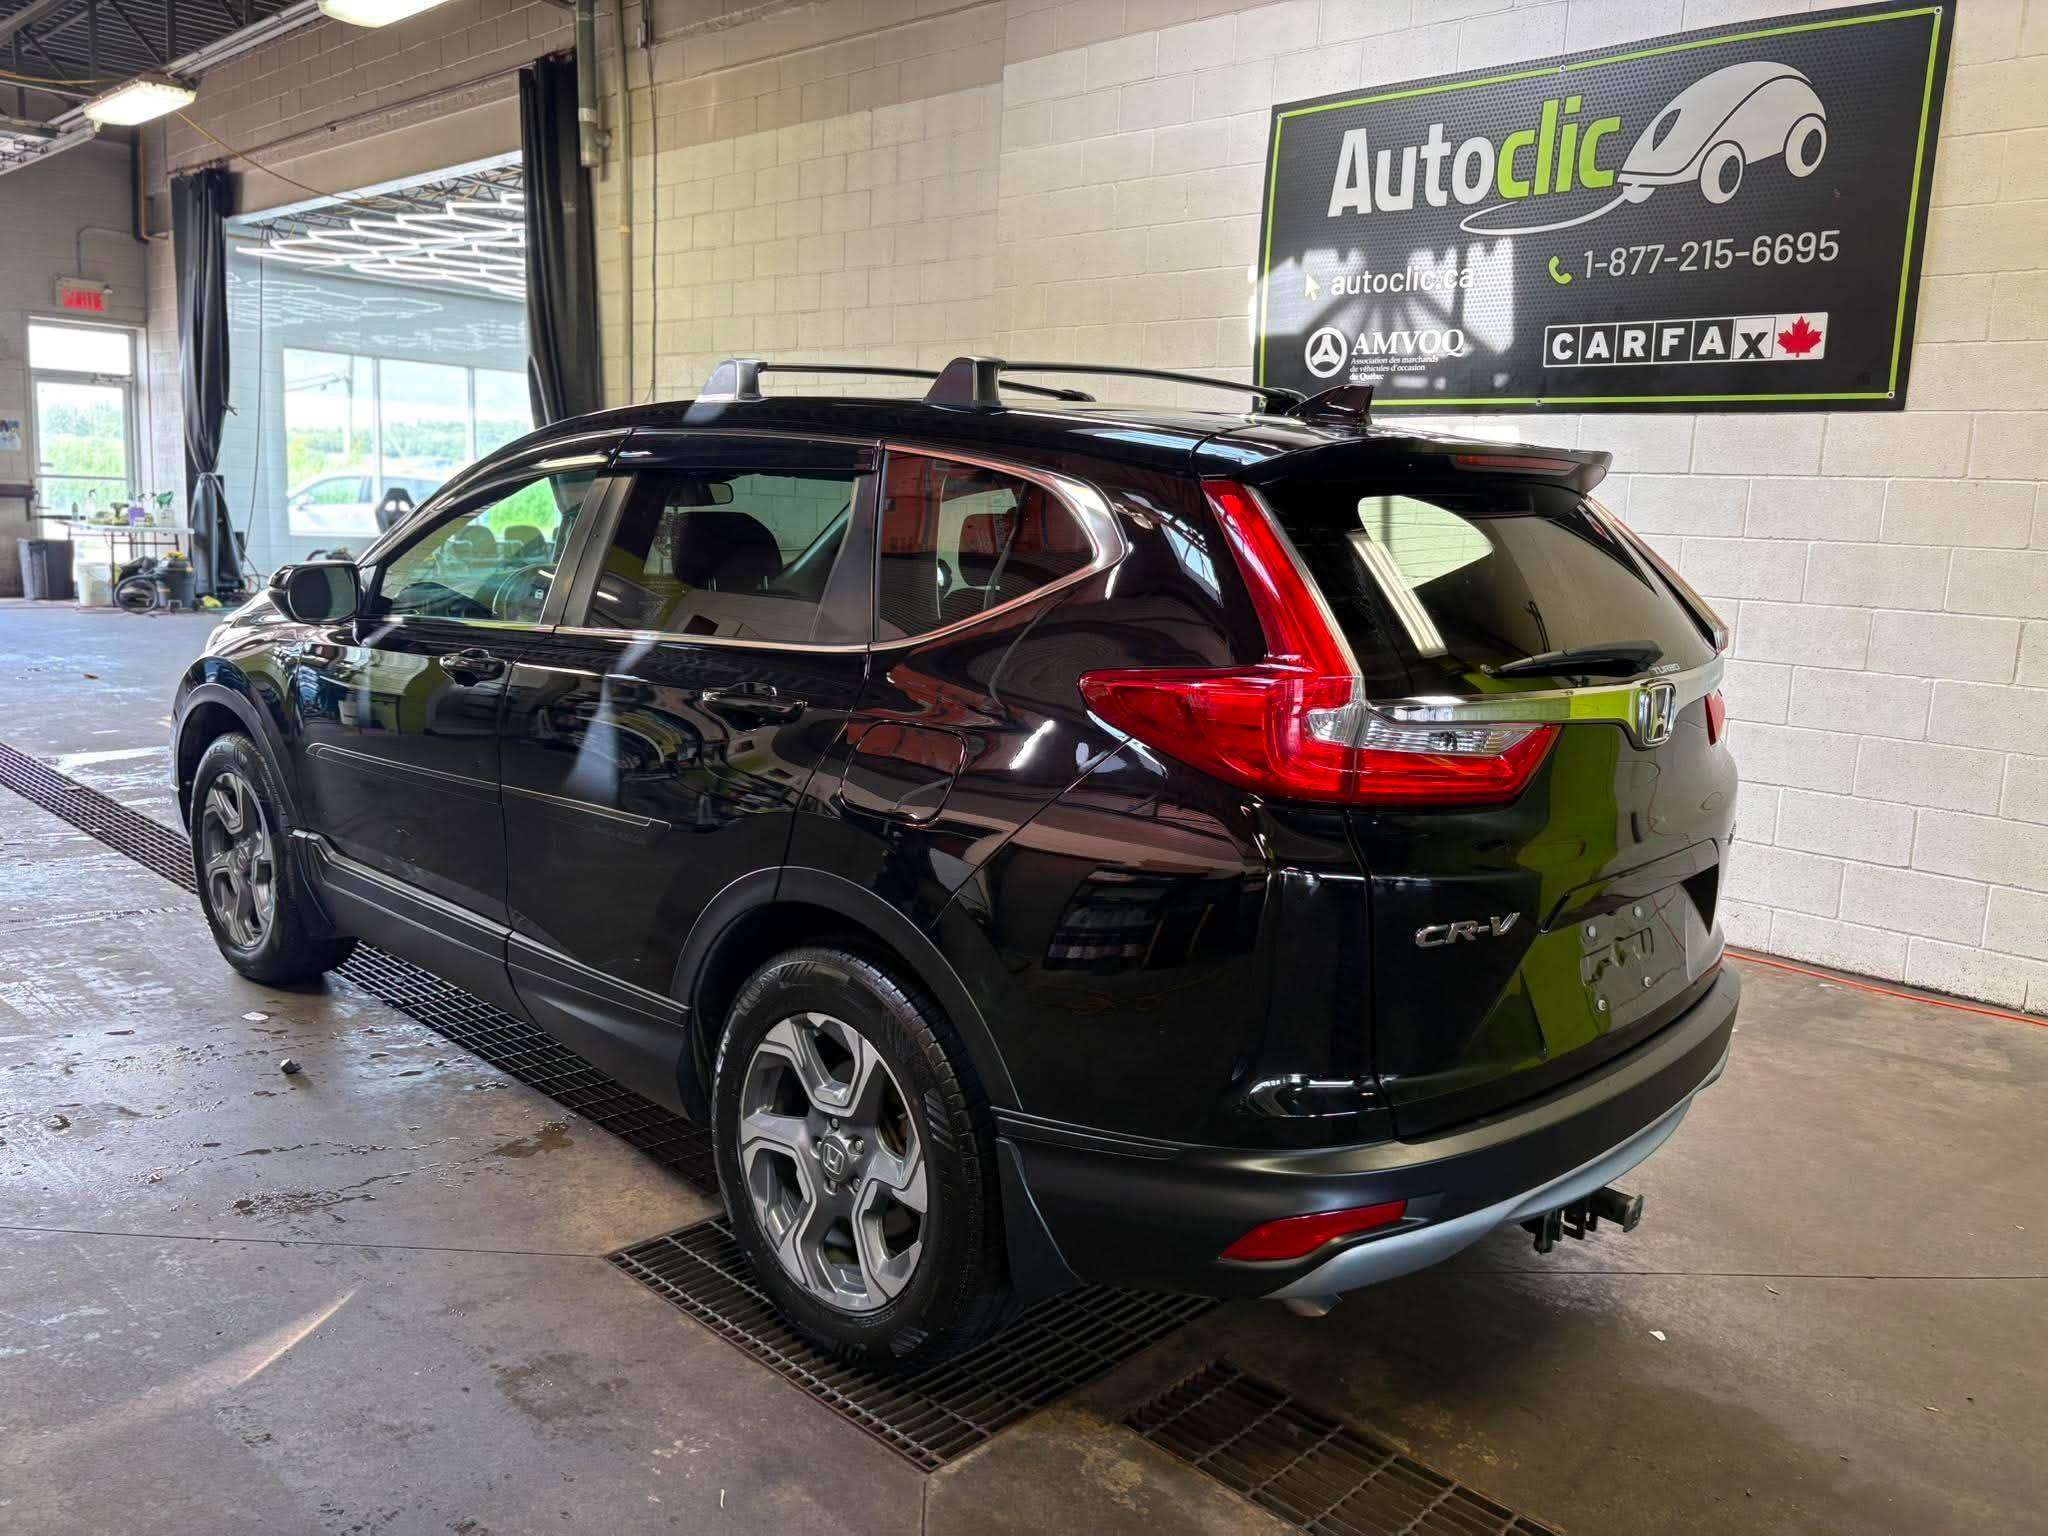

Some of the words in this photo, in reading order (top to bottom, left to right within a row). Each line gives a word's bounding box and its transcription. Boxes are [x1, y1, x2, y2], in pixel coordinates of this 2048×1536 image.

[1327, 94, 1622, 218] Autoclic
[1584, 230, 1841, 279] 1-877-215-6695
[1330, 264, 1475, 297] autoclic.ca
[1351, 329, 1466, 358] AMVOQ
[1551, 325, 1769, 360] CARFAX
[1349, 365, 1359, 373] de
[1360, 365, 1389, 373] véhicules
[1391, 363, 1426, 372] d'occasion
[1351, 357, 1388, 365] Association
[1389, 356, 1401, 364] des
[1402, 355, 1439, 363] marchands
[1349, 373, 1358, 381] du
[1415, 912, 1520, 947] CR-V
